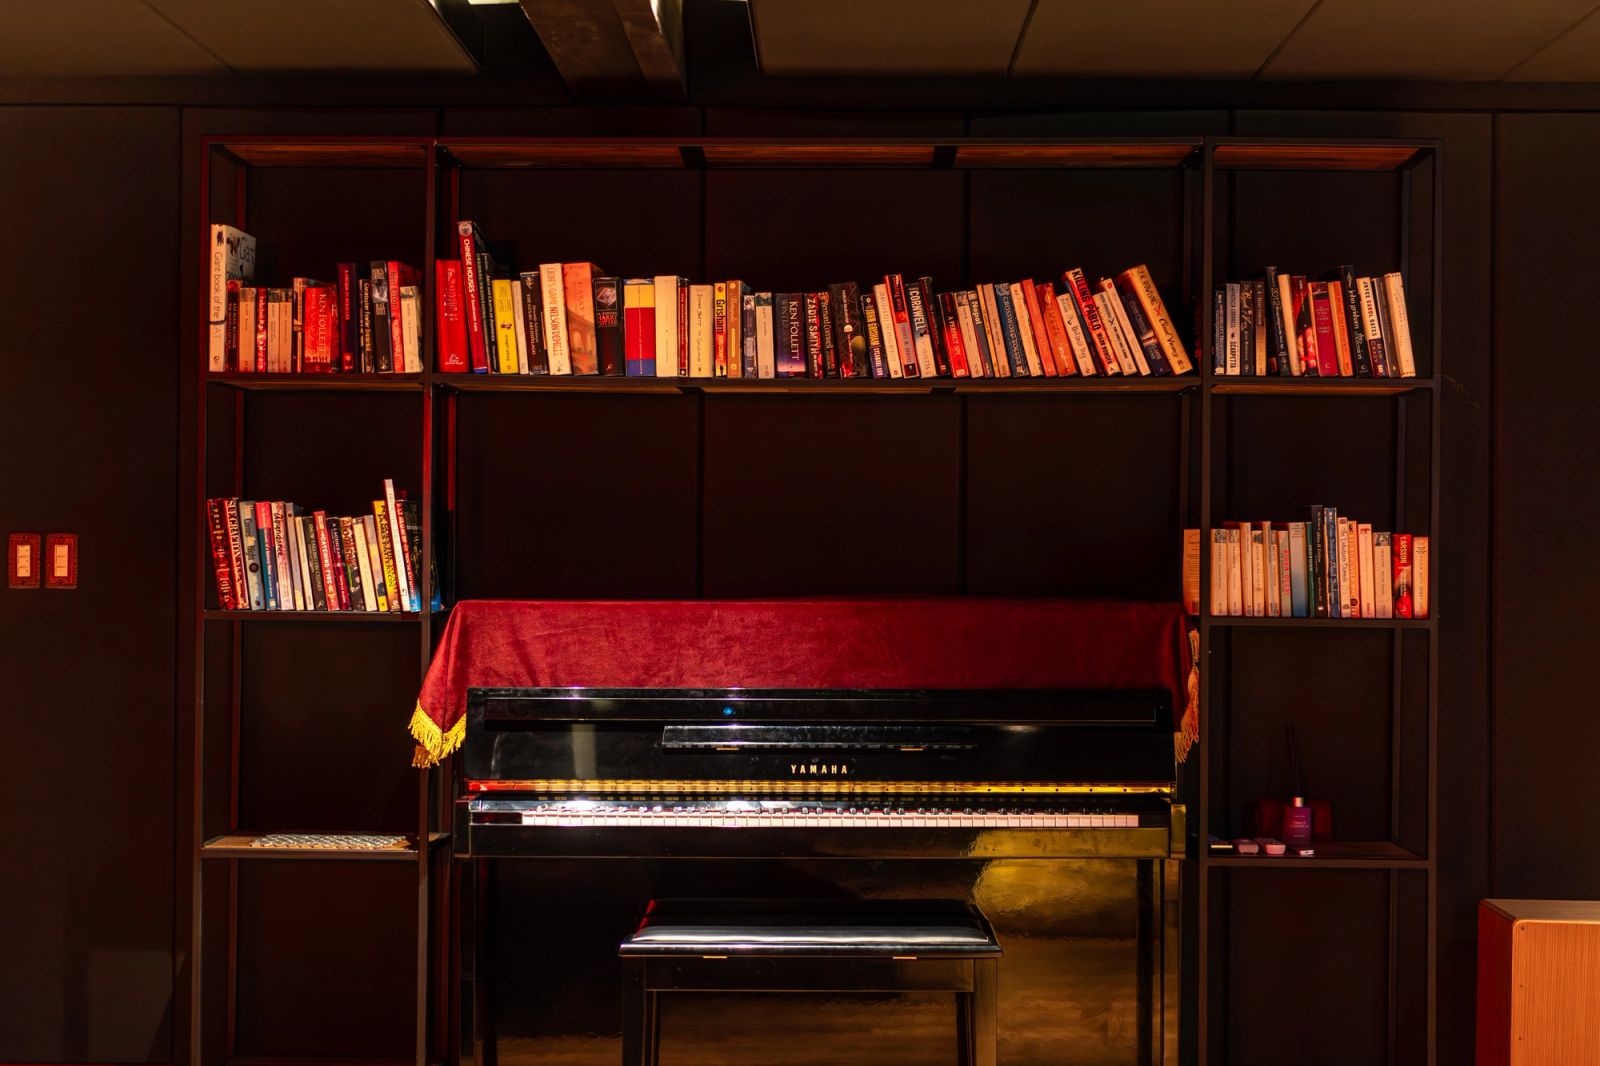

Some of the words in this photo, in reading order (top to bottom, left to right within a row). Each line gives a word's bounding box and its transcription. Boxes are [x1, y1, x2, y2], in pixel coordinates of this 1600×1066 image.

[213, 251, 222, 271] Giant
[463, 238, 472, 265] CHINESE
[213, 274, 222, 292] book
[466, 266, 475, 292] HOUSES
[1071, 269, 1091, 303] KILLING
[1361, 280, 1370, 298] JOYCE
[212, 296, 221, 305] of
[318, 294, 326, 312] KEN
[390, 287, 400, 309] Elton
[1141, 279, 1158, 306] ROWLING
[1269, 286, 1280, 307] 2012
[1347, 289, 1357, 304] john
[212, 306, 221, 318] the
[549, 306, 560, 330] NELSON
[715, 299, 725, 333] Grisham
[789, 301, 798, 319] KEN
[806, 298, 816, 323] ZADIE
[865, 308, 876, 323] JOHN
[908, 289, 926, 330] CORNWELL
[970, 300, 981, 325] Nepal
[1083, 302, 1101, 331] PABLO
[1349, 304, 1361, 329] grisham
[1365, 299, 1374, 318] CAROL
[317, 314, 326, 353] FOLLETT
[528, 321, 536, 354] ARCHIPELAGO
[867, 322, 880, 346] GRISHAM
[948, 320, 959, 345] PERFECT
[1001, 295, 1016, 338] CROSSWORD
[1010, 336, 1022, 365] SOLVER
[1368, 318, 1377, 336] OATES
[789, 321, 799, 360] FOLLETT
[808, 324, 819, 354] SMITH
[953, 345, 961, 355] SPY
[1095, 331, 1106, 347] MARK
[1100, 345, 1112, 365] BOWDEN
[226, 500, 237, 516] SUE
[228, 516, 242, 558] GRAFTON
[243, 518, 254, 537] Comes
[272, 512, 287, 557] Abundance
[244, 545, 256, 560] Night
[310, 539, 318, 561] FALLING
[319, 536, 330, 567] CATCHING
[331, 527, 341, 559] LAODICEAN
[377, 513, 385, 539] JAMES
[381, 541, 393, 587] PATTERSON
[1398, 536, 1407, 563] LARSSON
[313, 561, 319, 570] ON
[324, 568, 333, 584] FIRE
[314, 570, 322, 591] CEDARS
[790, 764, 847, 774] YAMAHA
